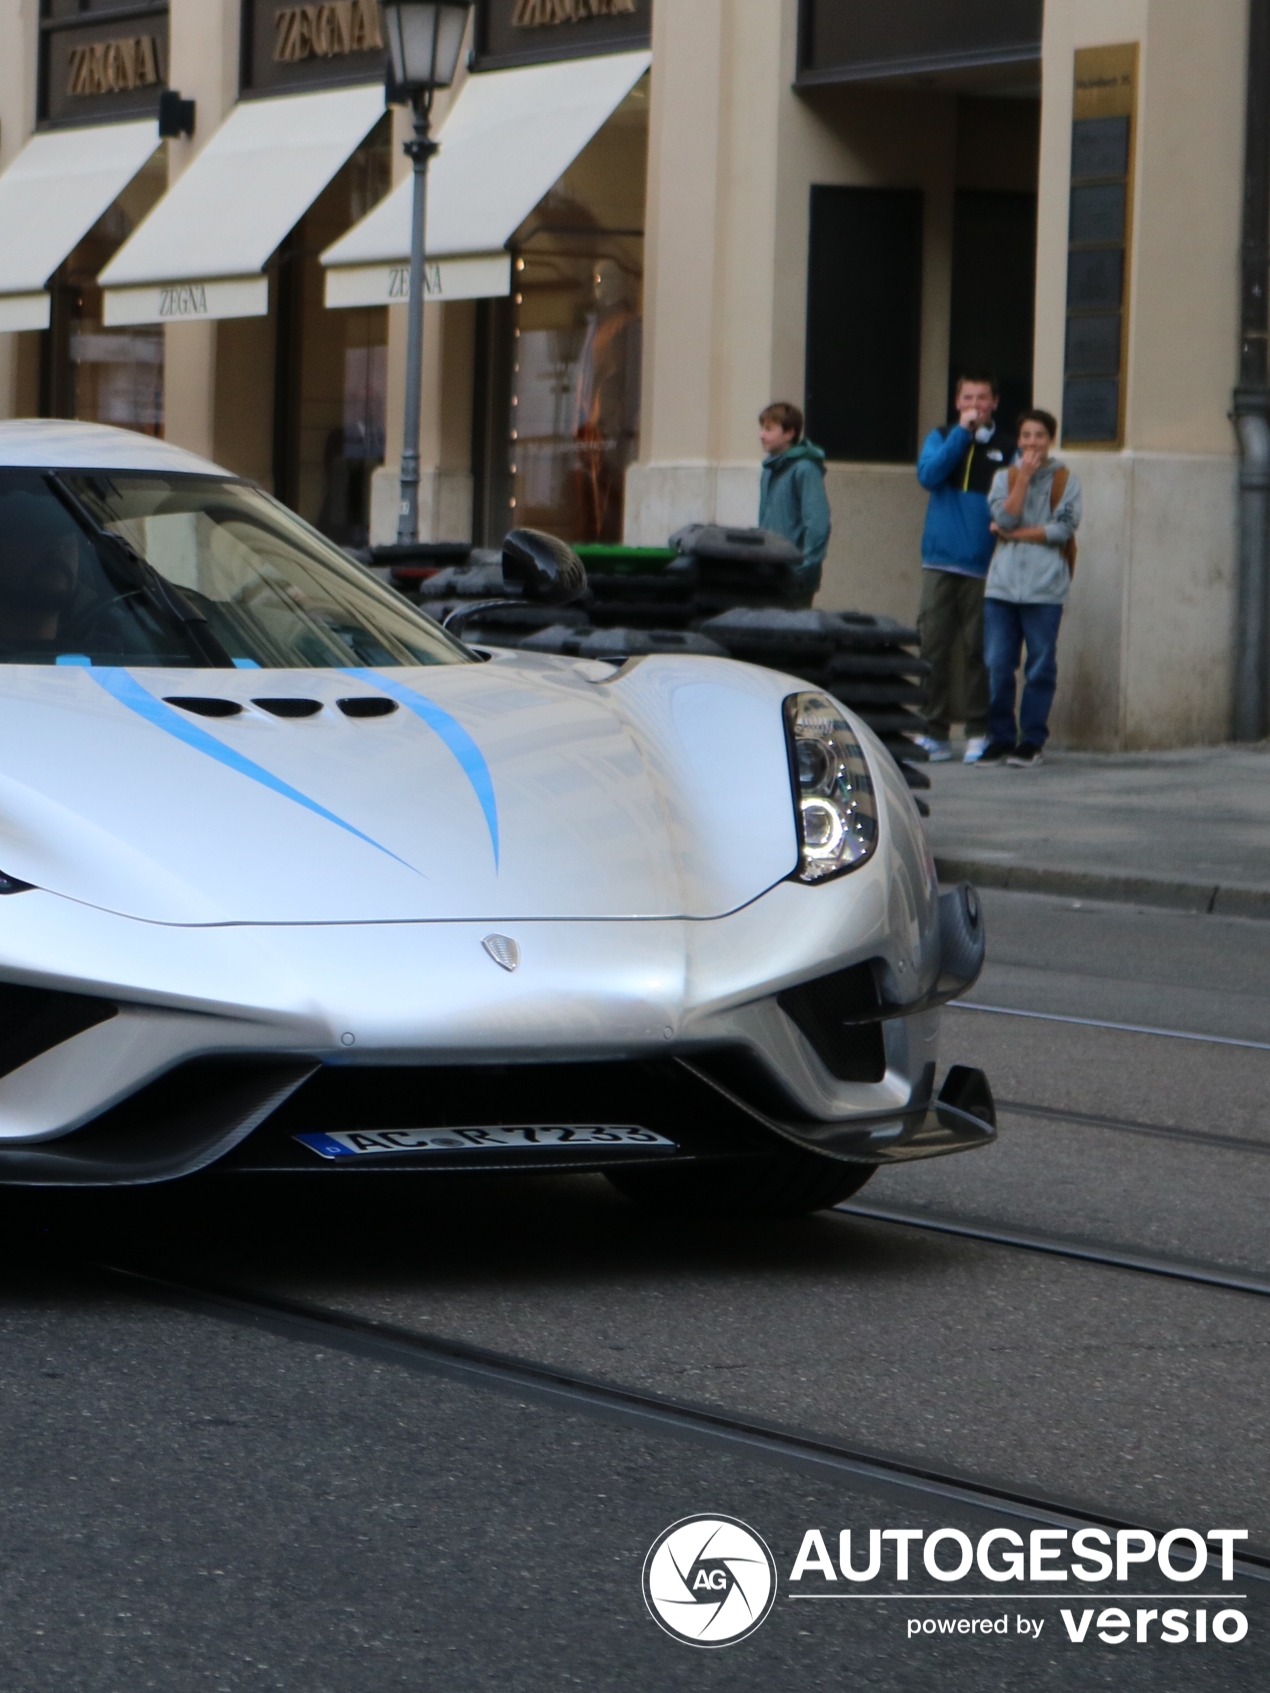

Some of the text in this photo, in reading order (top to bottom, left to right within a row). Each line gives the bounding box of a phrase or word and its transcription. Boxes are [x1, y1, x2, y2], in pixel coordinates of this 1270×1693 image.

[273, 0, 383, 61] ZEGNA
[67, 35, 157, 95] ZEGNA
[389, 266, 442, 297] ZENA
[159, 285, 208, 317] ZEGNA
[346, 1125, 661, 1151] AC R 7233
